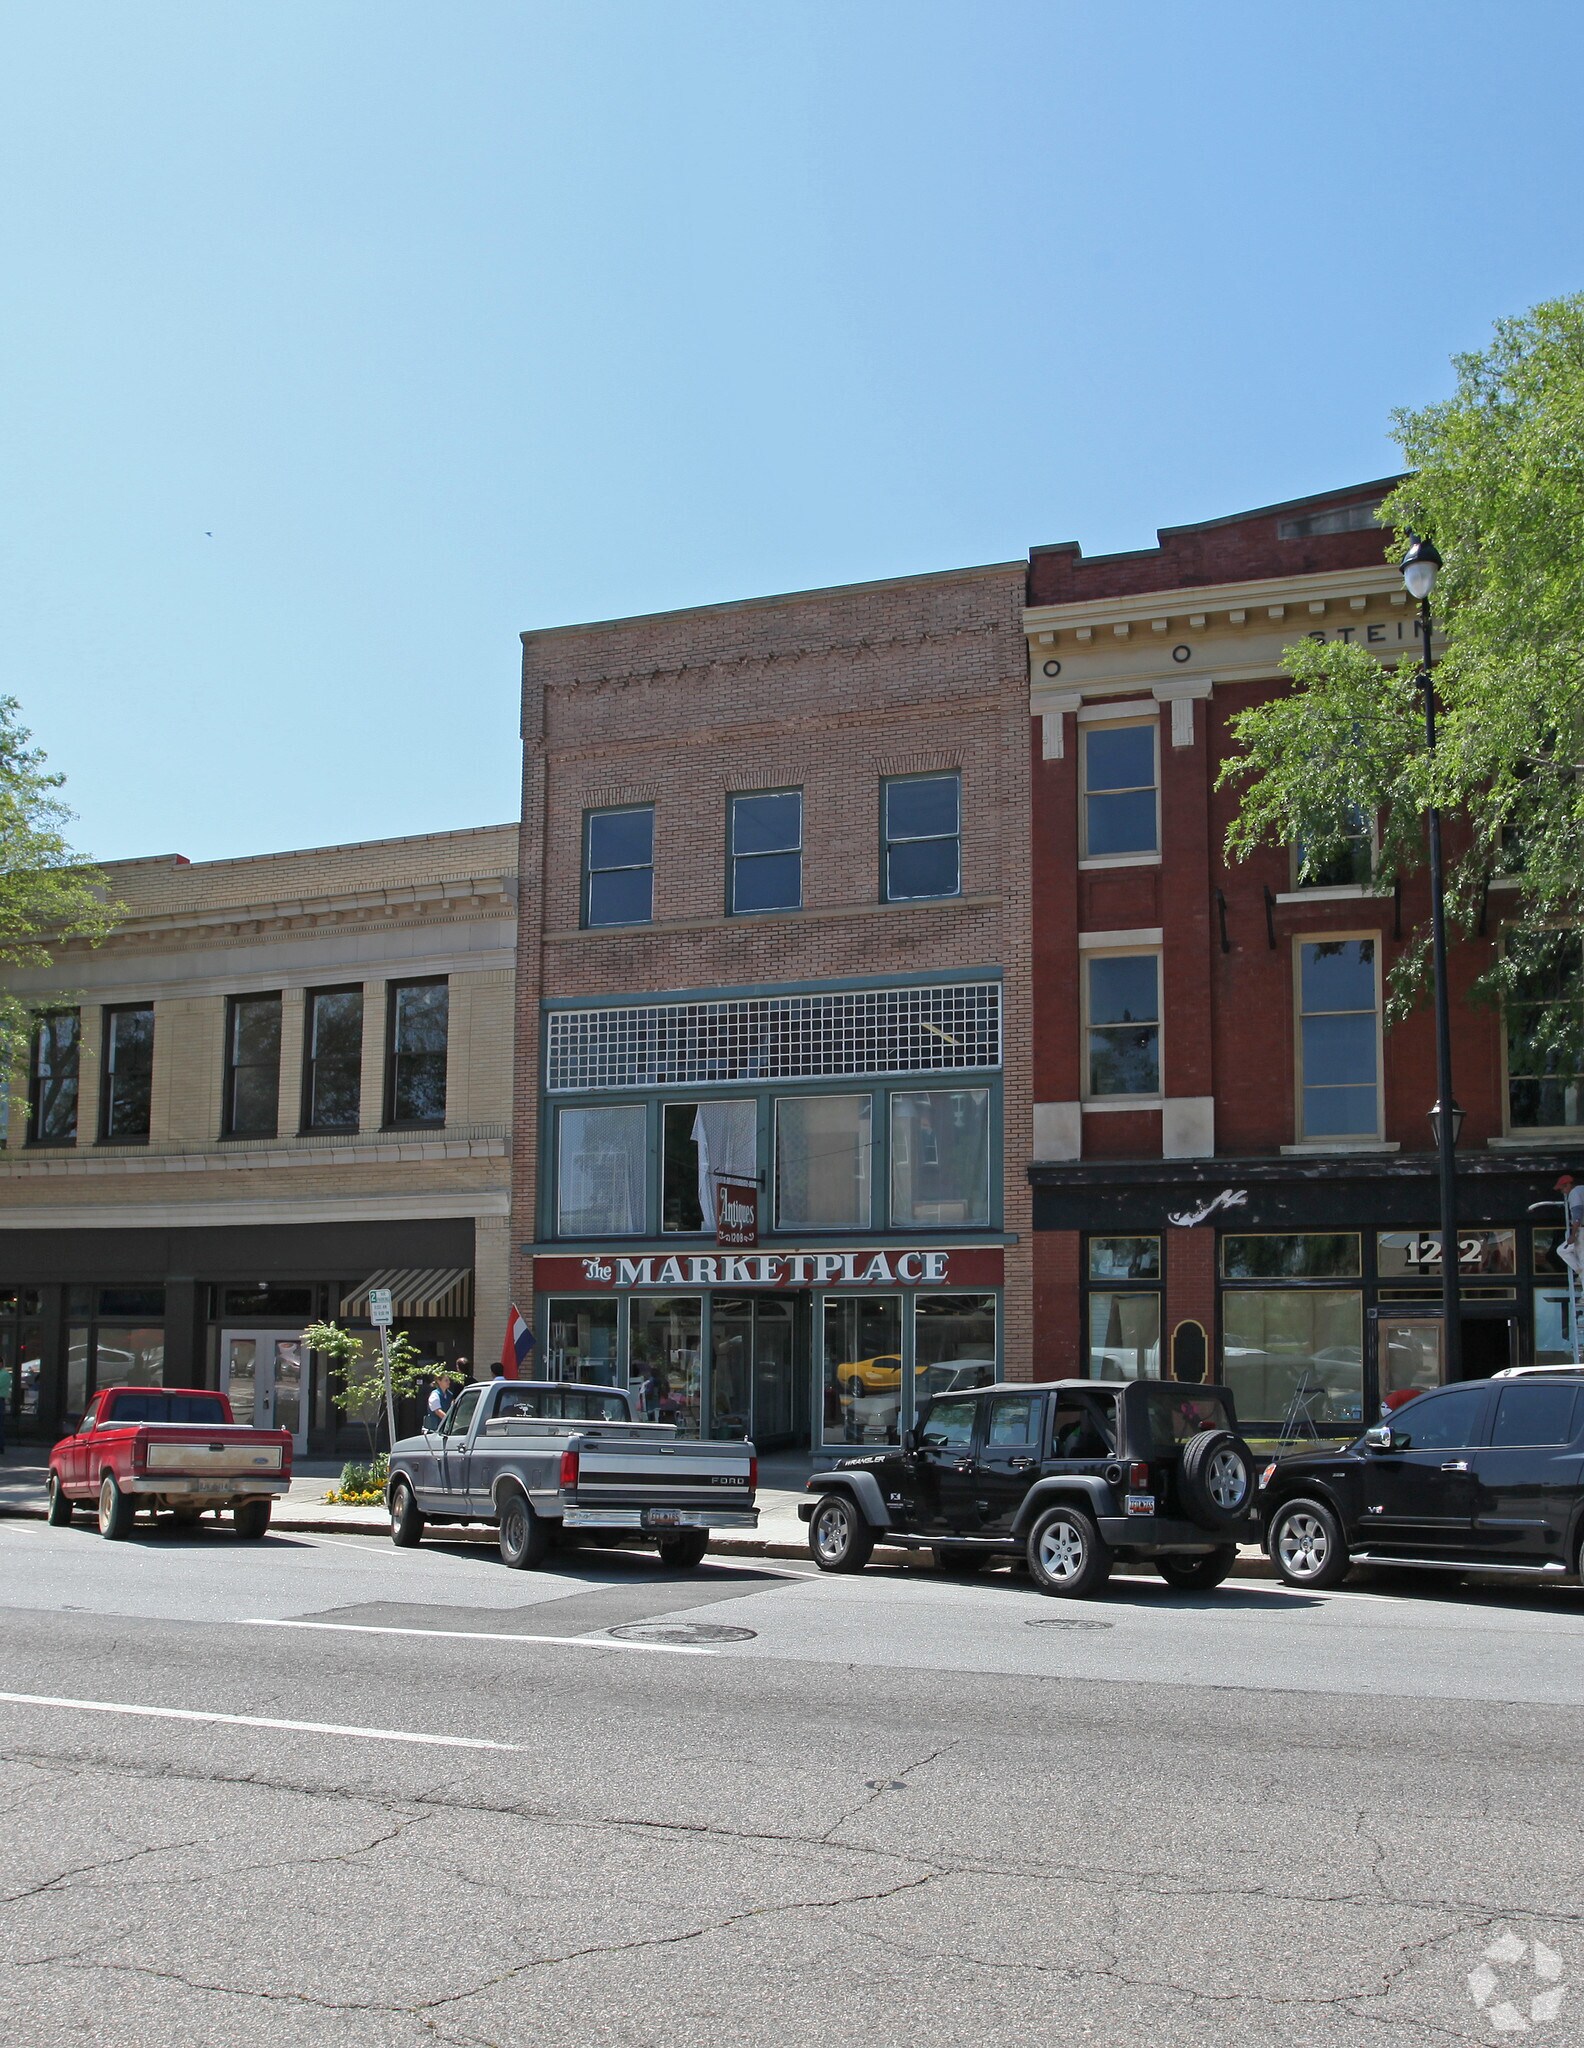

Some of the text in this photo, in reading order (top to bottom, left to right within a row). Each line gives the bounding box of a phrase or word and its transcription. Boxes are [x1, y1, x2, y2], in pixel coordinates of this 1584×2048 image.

[1308, 619, 1433, 646] STEIN
[718, 1187, 755, 1230] Antiques
[1407, 1239, 1482, 1263] 122
[582, 1251, 950, 1288] The MARKETPLACE
[371, 1292, 376, 1302] 2
[845, 1455, 886, 1466] WRANGLER
